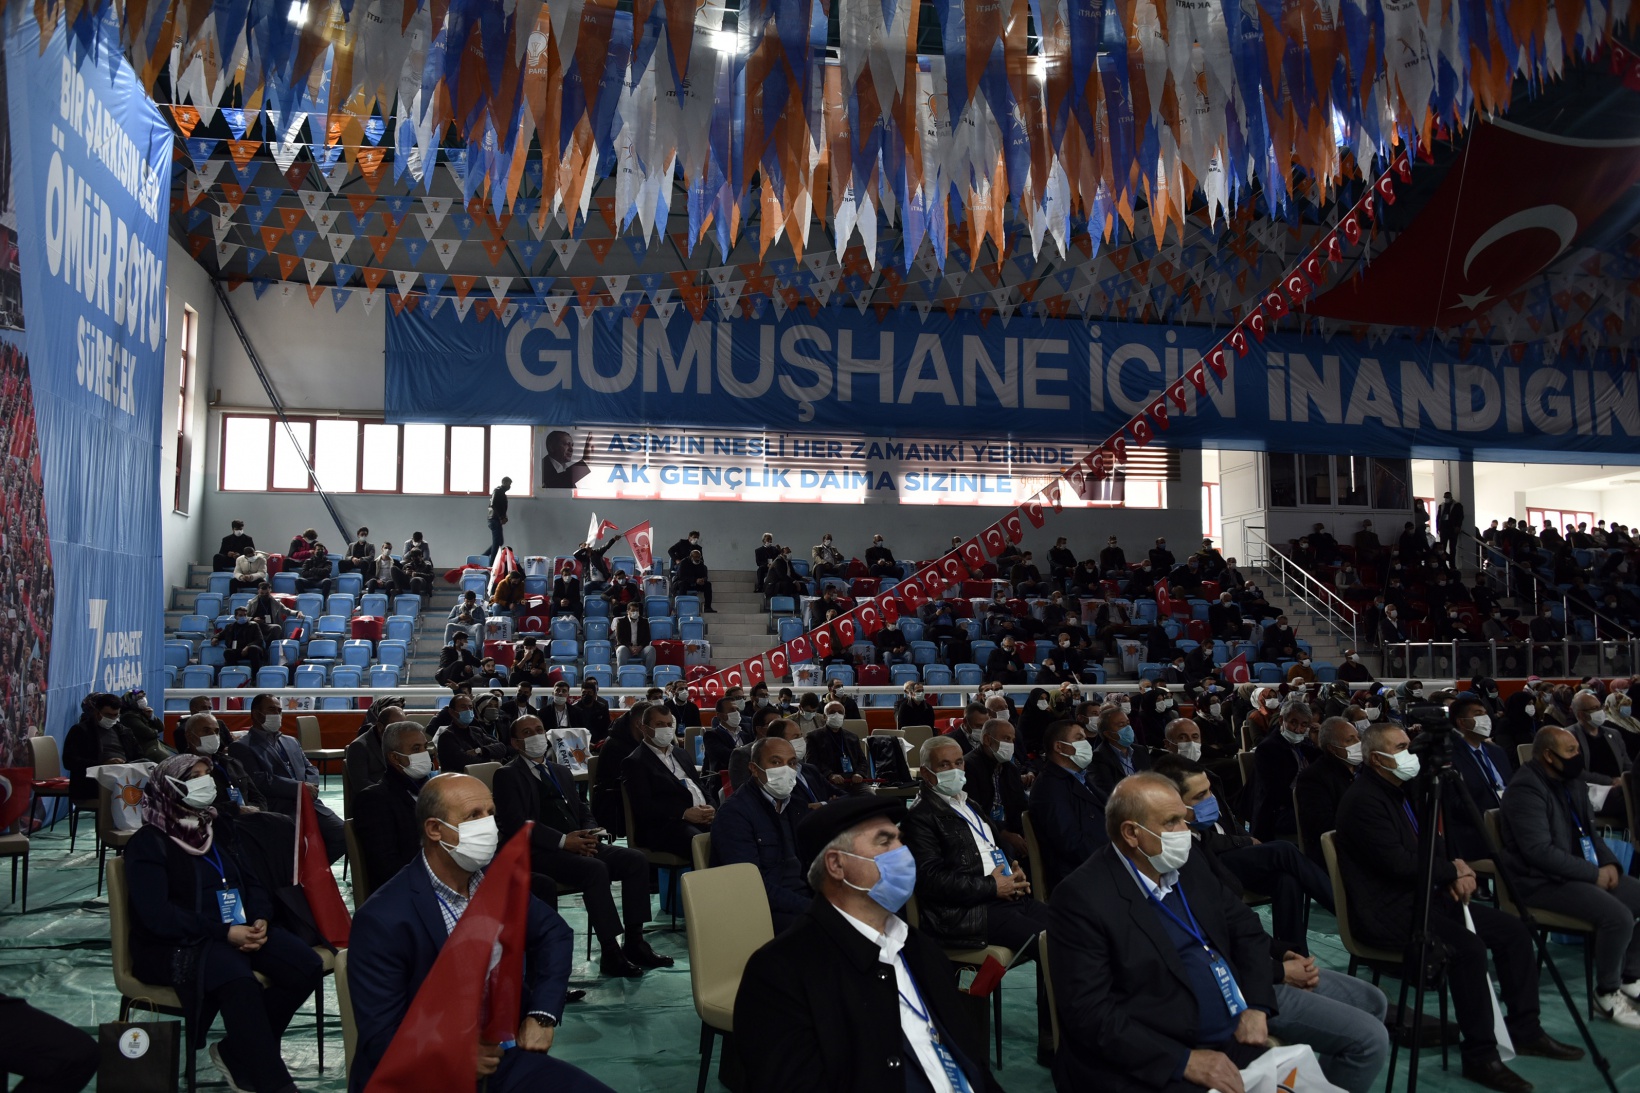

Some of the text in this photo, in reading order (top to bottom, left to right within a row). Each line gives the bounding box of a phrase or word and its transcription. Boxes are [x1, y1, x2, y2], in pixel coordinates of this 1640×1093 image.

[528, 67, 548, 76] PART
[60, 53, 85, 138] BİR
[1012, 138, 1024, 146] AK
[46, 123, 163, 352] ÖMÜR BOYU
[76, 314, 137, 417] SÜRECEK
[713, 434, 785, 457] NESLİ
[793, 439, 843, 458] HER
[850, 440, 964, 462] ZAMANKİ
[971, 441, 1074, 465] YERİNDE
[607, 463, 650, 483] AK
[659, 463, 791, 490] GENÇLİK
[800, 465, 896, 491] DAİMA
[904, 467, 1012, 493] SİZİNLE
[104, 631, 118, 659] AK
[560, 749, 571, 768] PART
